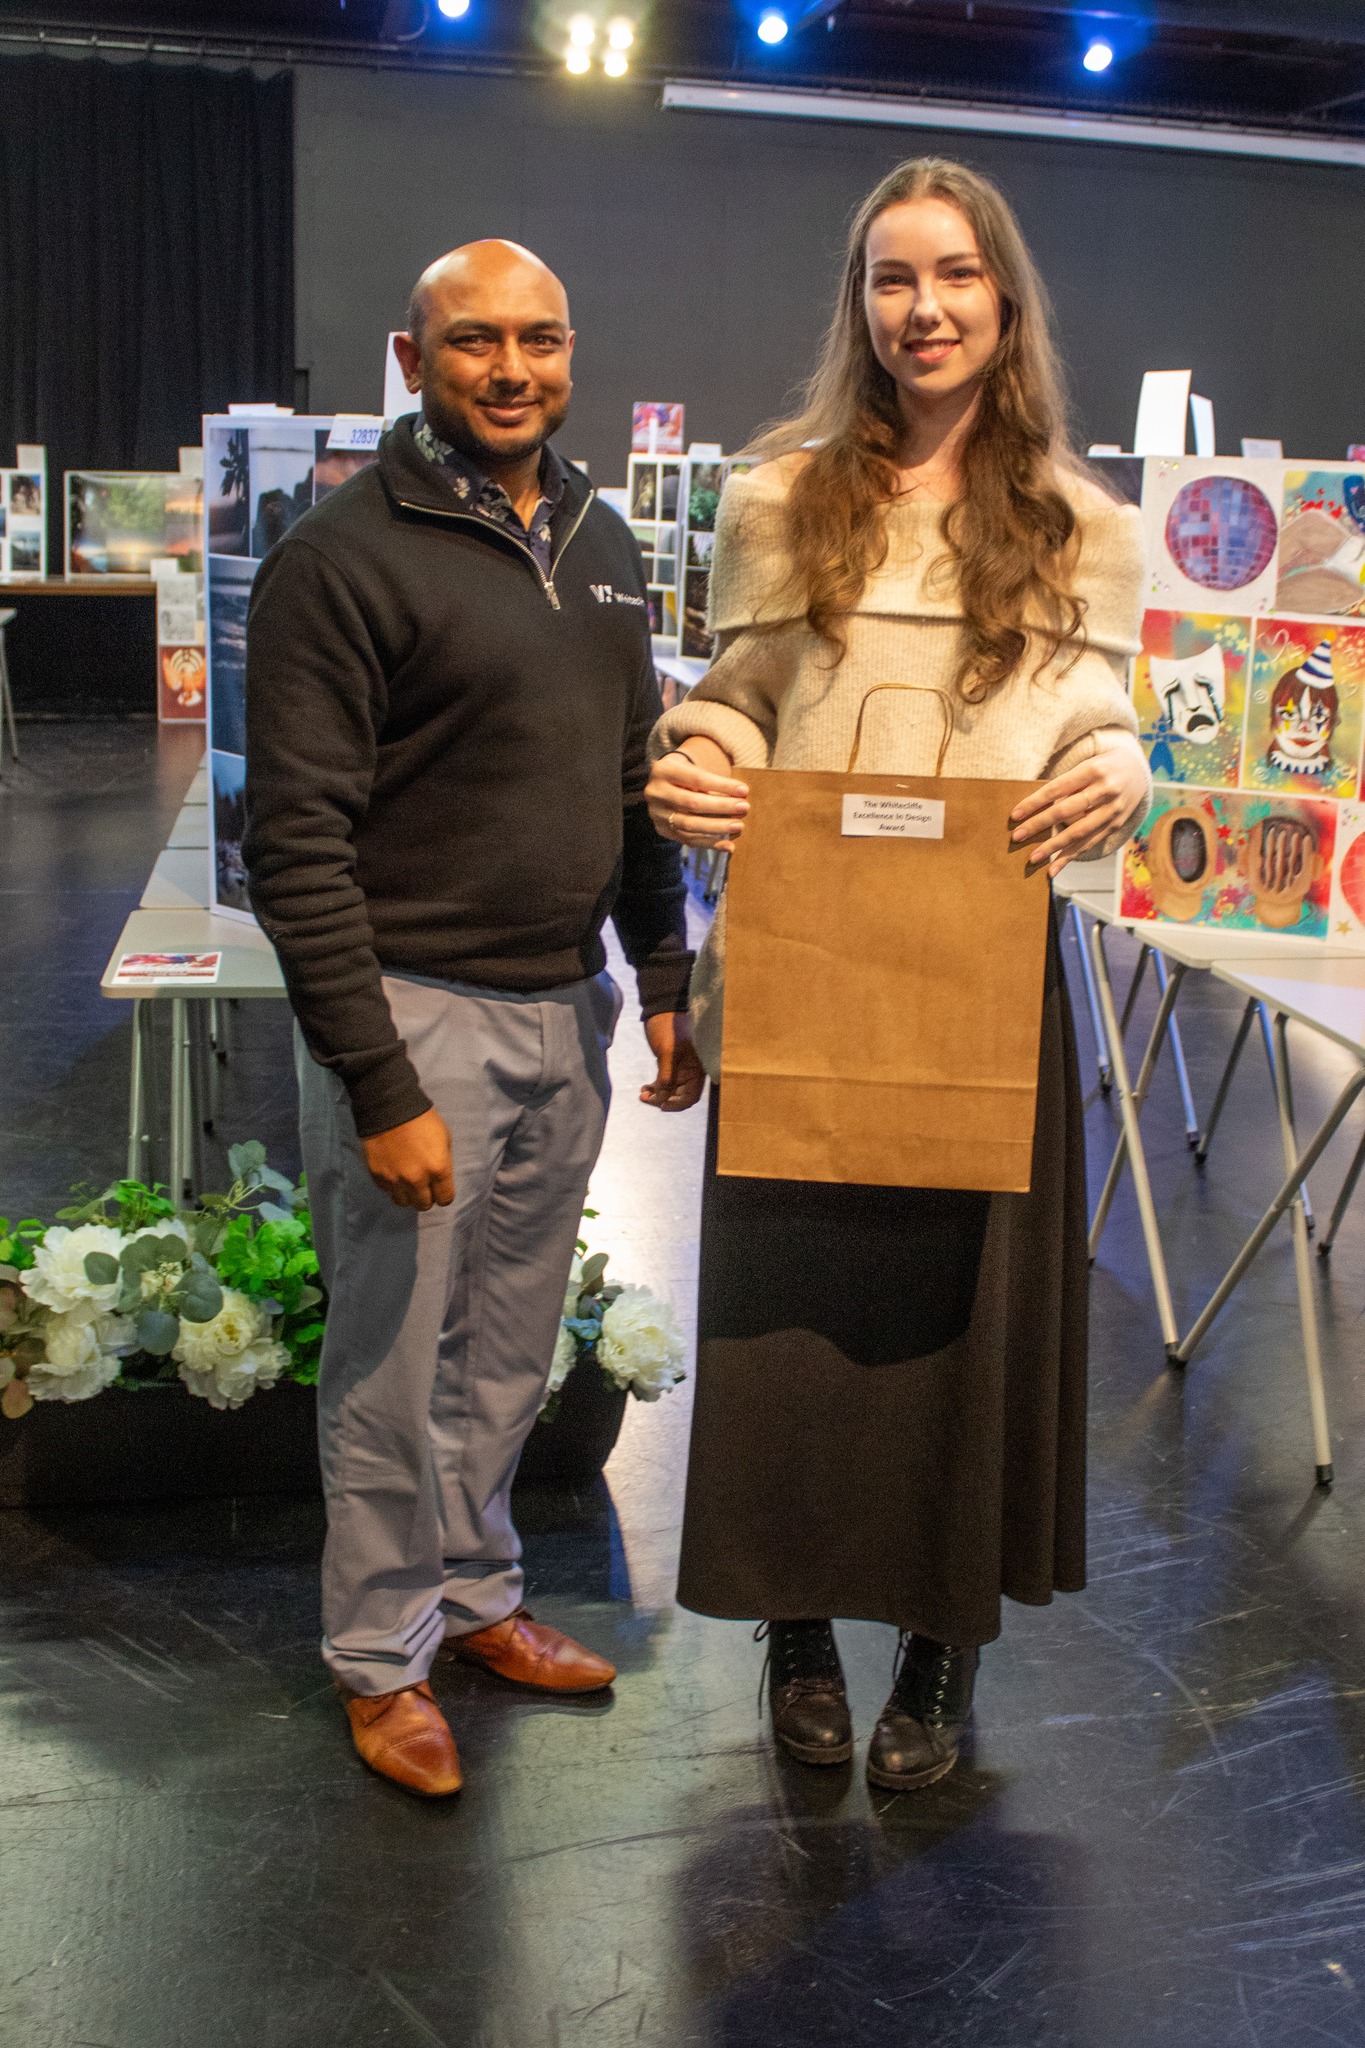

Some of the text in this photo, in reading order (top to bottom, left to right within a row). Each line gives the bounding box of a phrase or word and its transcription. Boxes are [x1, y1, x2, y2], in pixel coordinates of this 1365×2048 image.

[350, 429, 379, 444] 32837
[864, 800, 877, 808] The
[853, 812, 893, 820] Excellence
[905, 813, 932, 823] Design
[879, 823, 905, 831] Award
